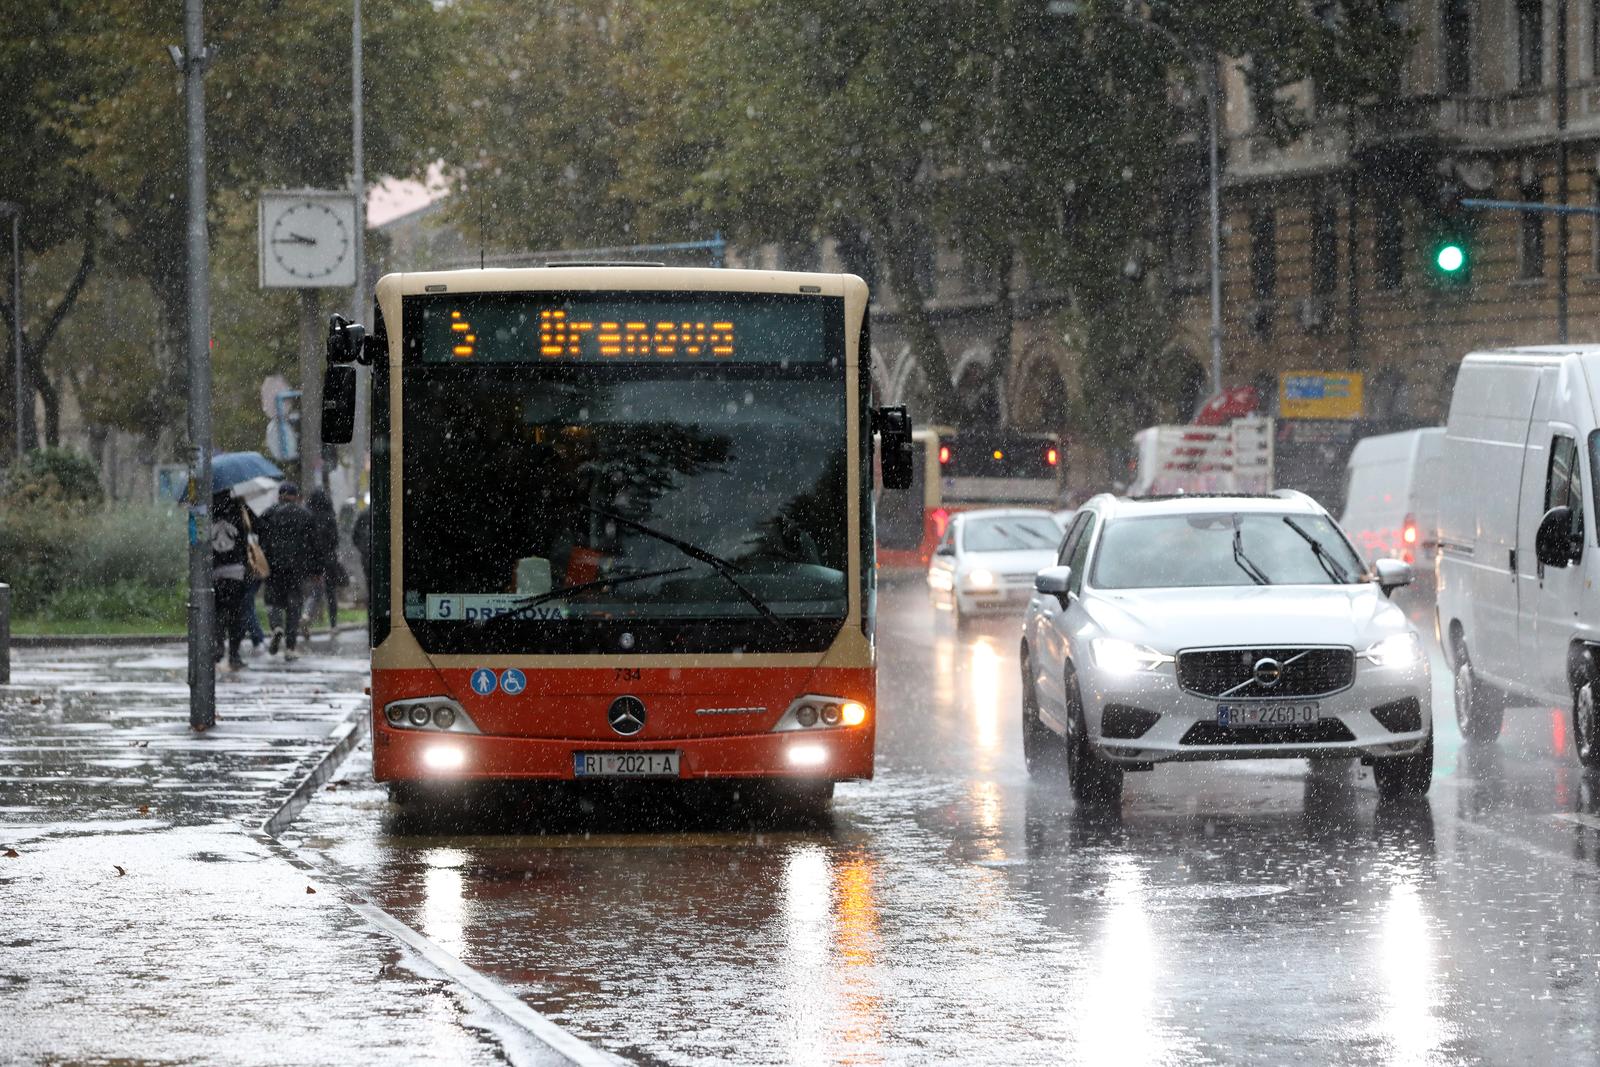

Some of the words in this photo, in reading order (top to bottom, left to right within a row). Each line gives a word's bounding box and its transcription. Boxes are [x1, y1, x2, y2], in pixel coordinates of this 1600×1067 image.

[438, 599, 451, 618] 5
[614, 667, 641, 681] 734
[1229, 708, 1246, 723] RI
[586, 756, 603, 772] RI
[617, 756, 672, 773] 2021-A
